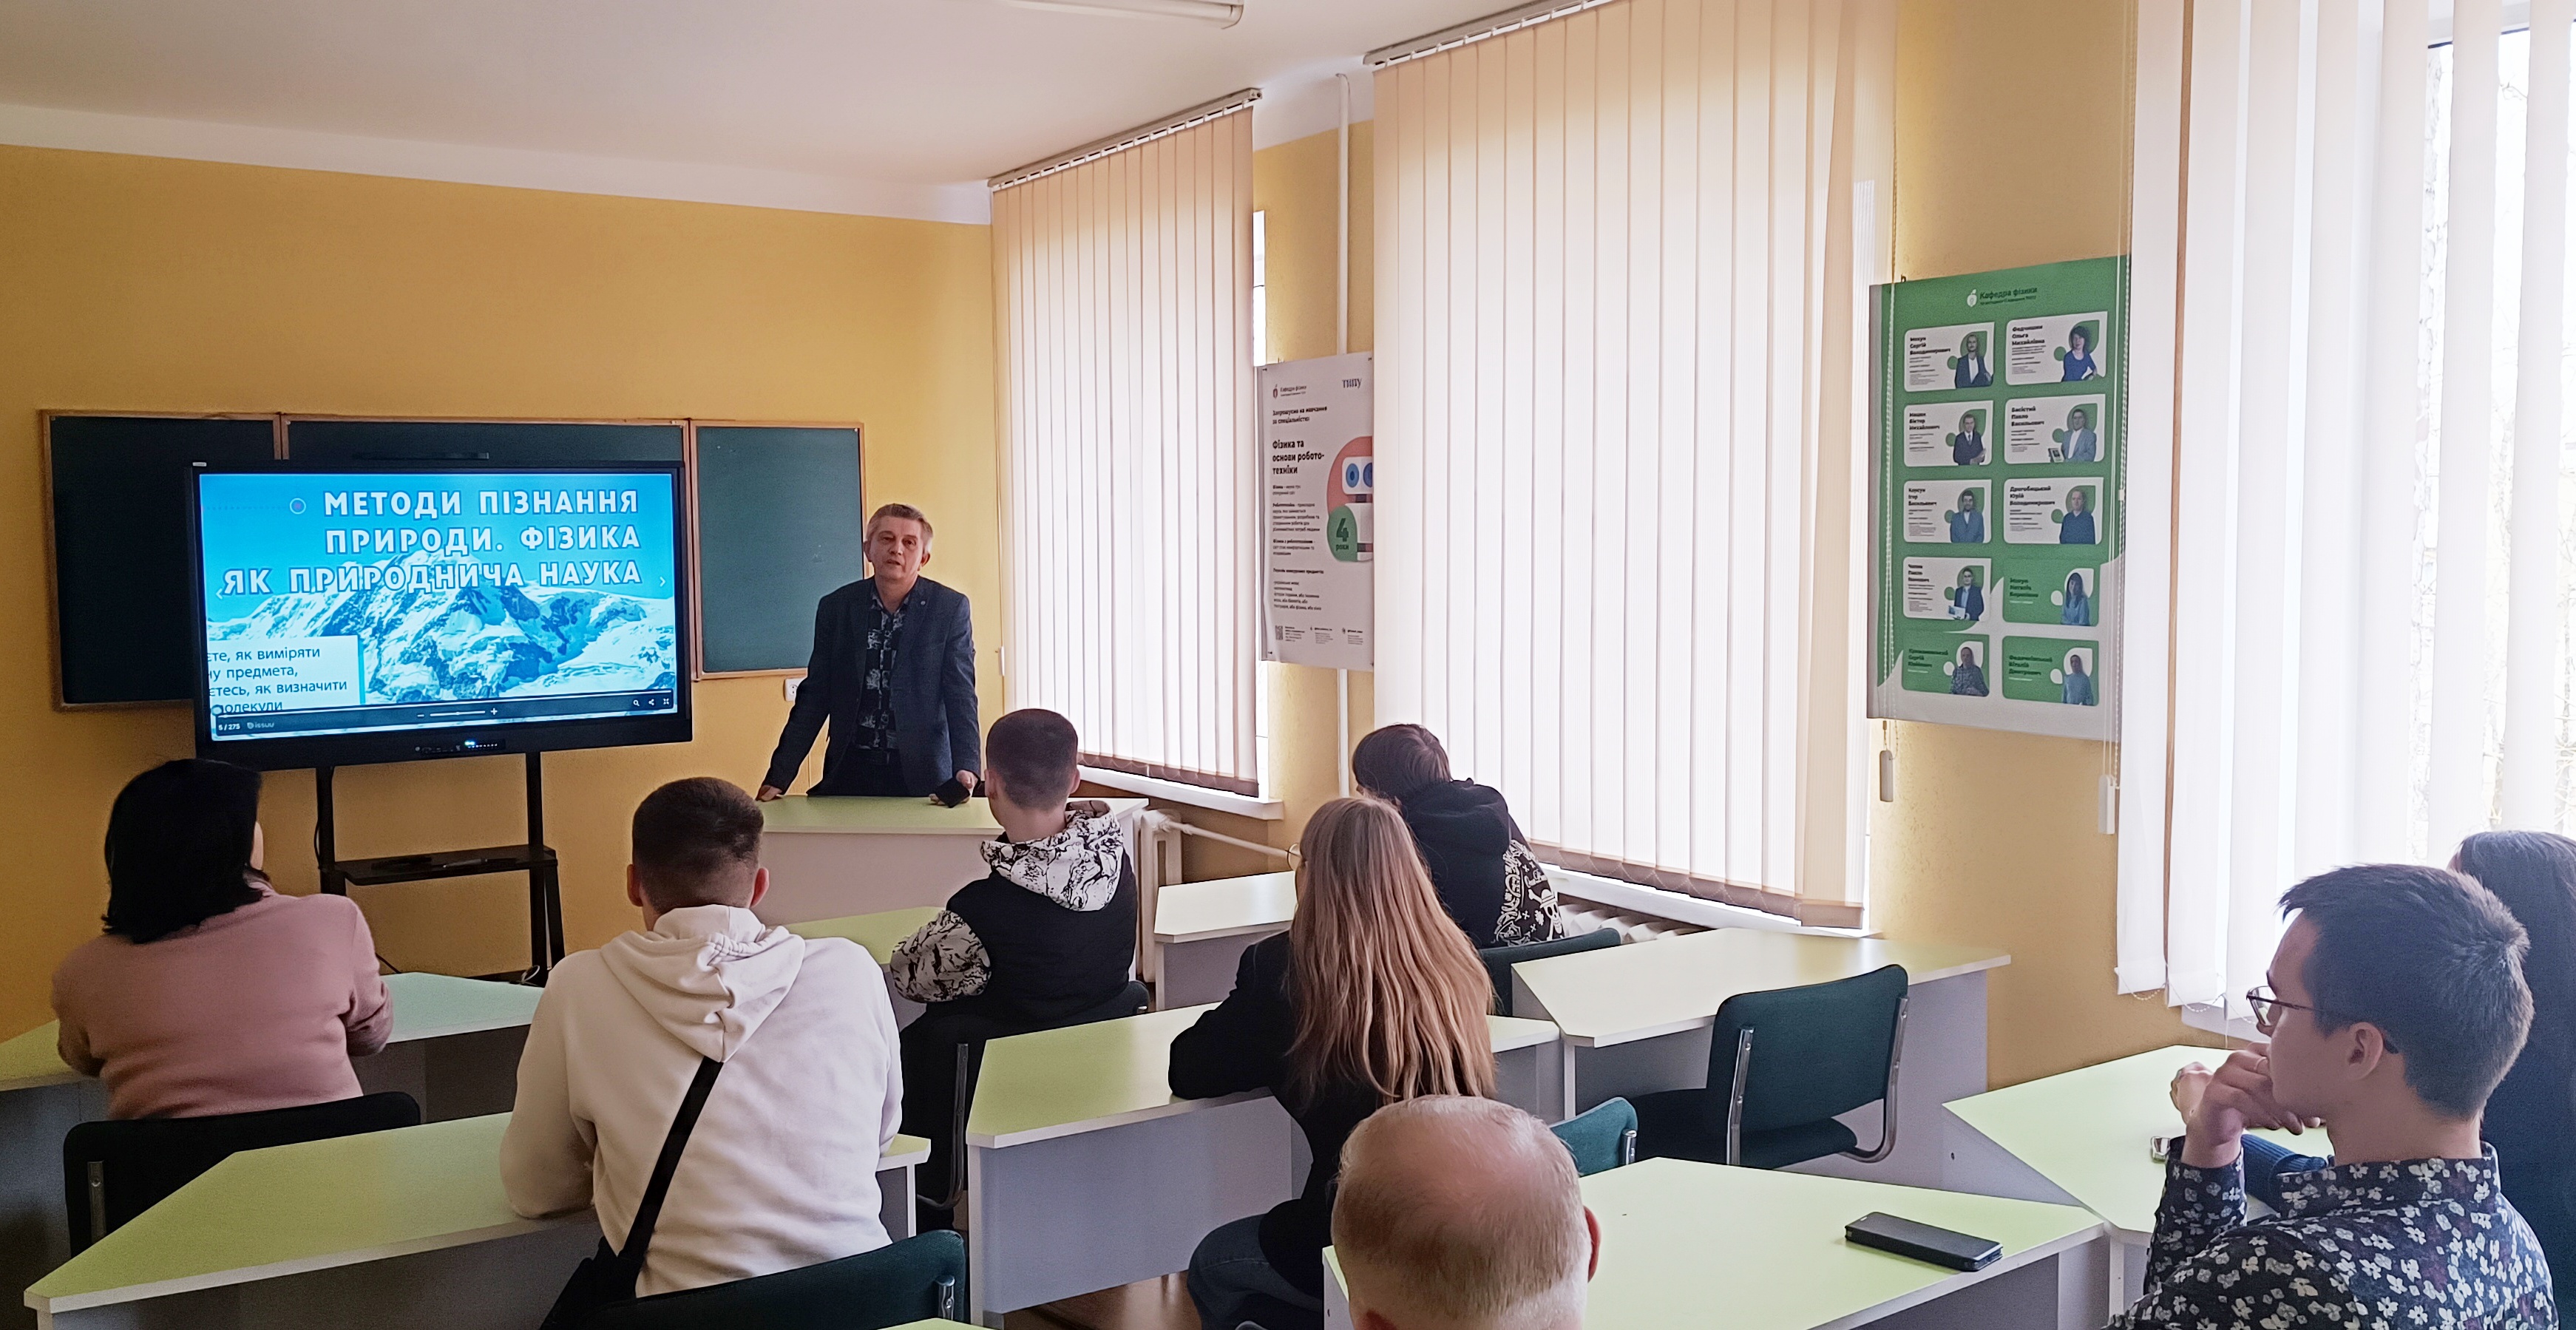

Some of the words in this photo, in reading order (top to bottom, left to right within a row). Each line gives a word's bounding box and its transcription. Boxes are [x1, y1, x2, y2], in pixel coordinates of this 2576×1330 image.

[1272, 439, 1295, 449] Фізика
[1272, 454, 1295, 462] основи
[1298, 451, 1324, 462] робото-
[1272, 464, 1298, 475] техніки
[324, 490, 461, 520] МЕТОДИ
[479, 489, 638, 515] ПІЗНАННЯ
[1336, 518, 1349, 542] 4
[325, 527, 504, 557] ПРИРОДИ.
[520, 524, 640, 550] ФІЗИКА
[223, 568, 272, 594] ЯК
[288, 562, 524, 595] ПРИРОДНИЧА
[540, 560, 642, 586] НАУКА
[236, 651, 252, 660] як
[257, 647, 320, 660] виміряти
[226, 666, 298, 680] предмета,
[255, 684, 271, 694] як
[277, 681, 347, 694] визначити
